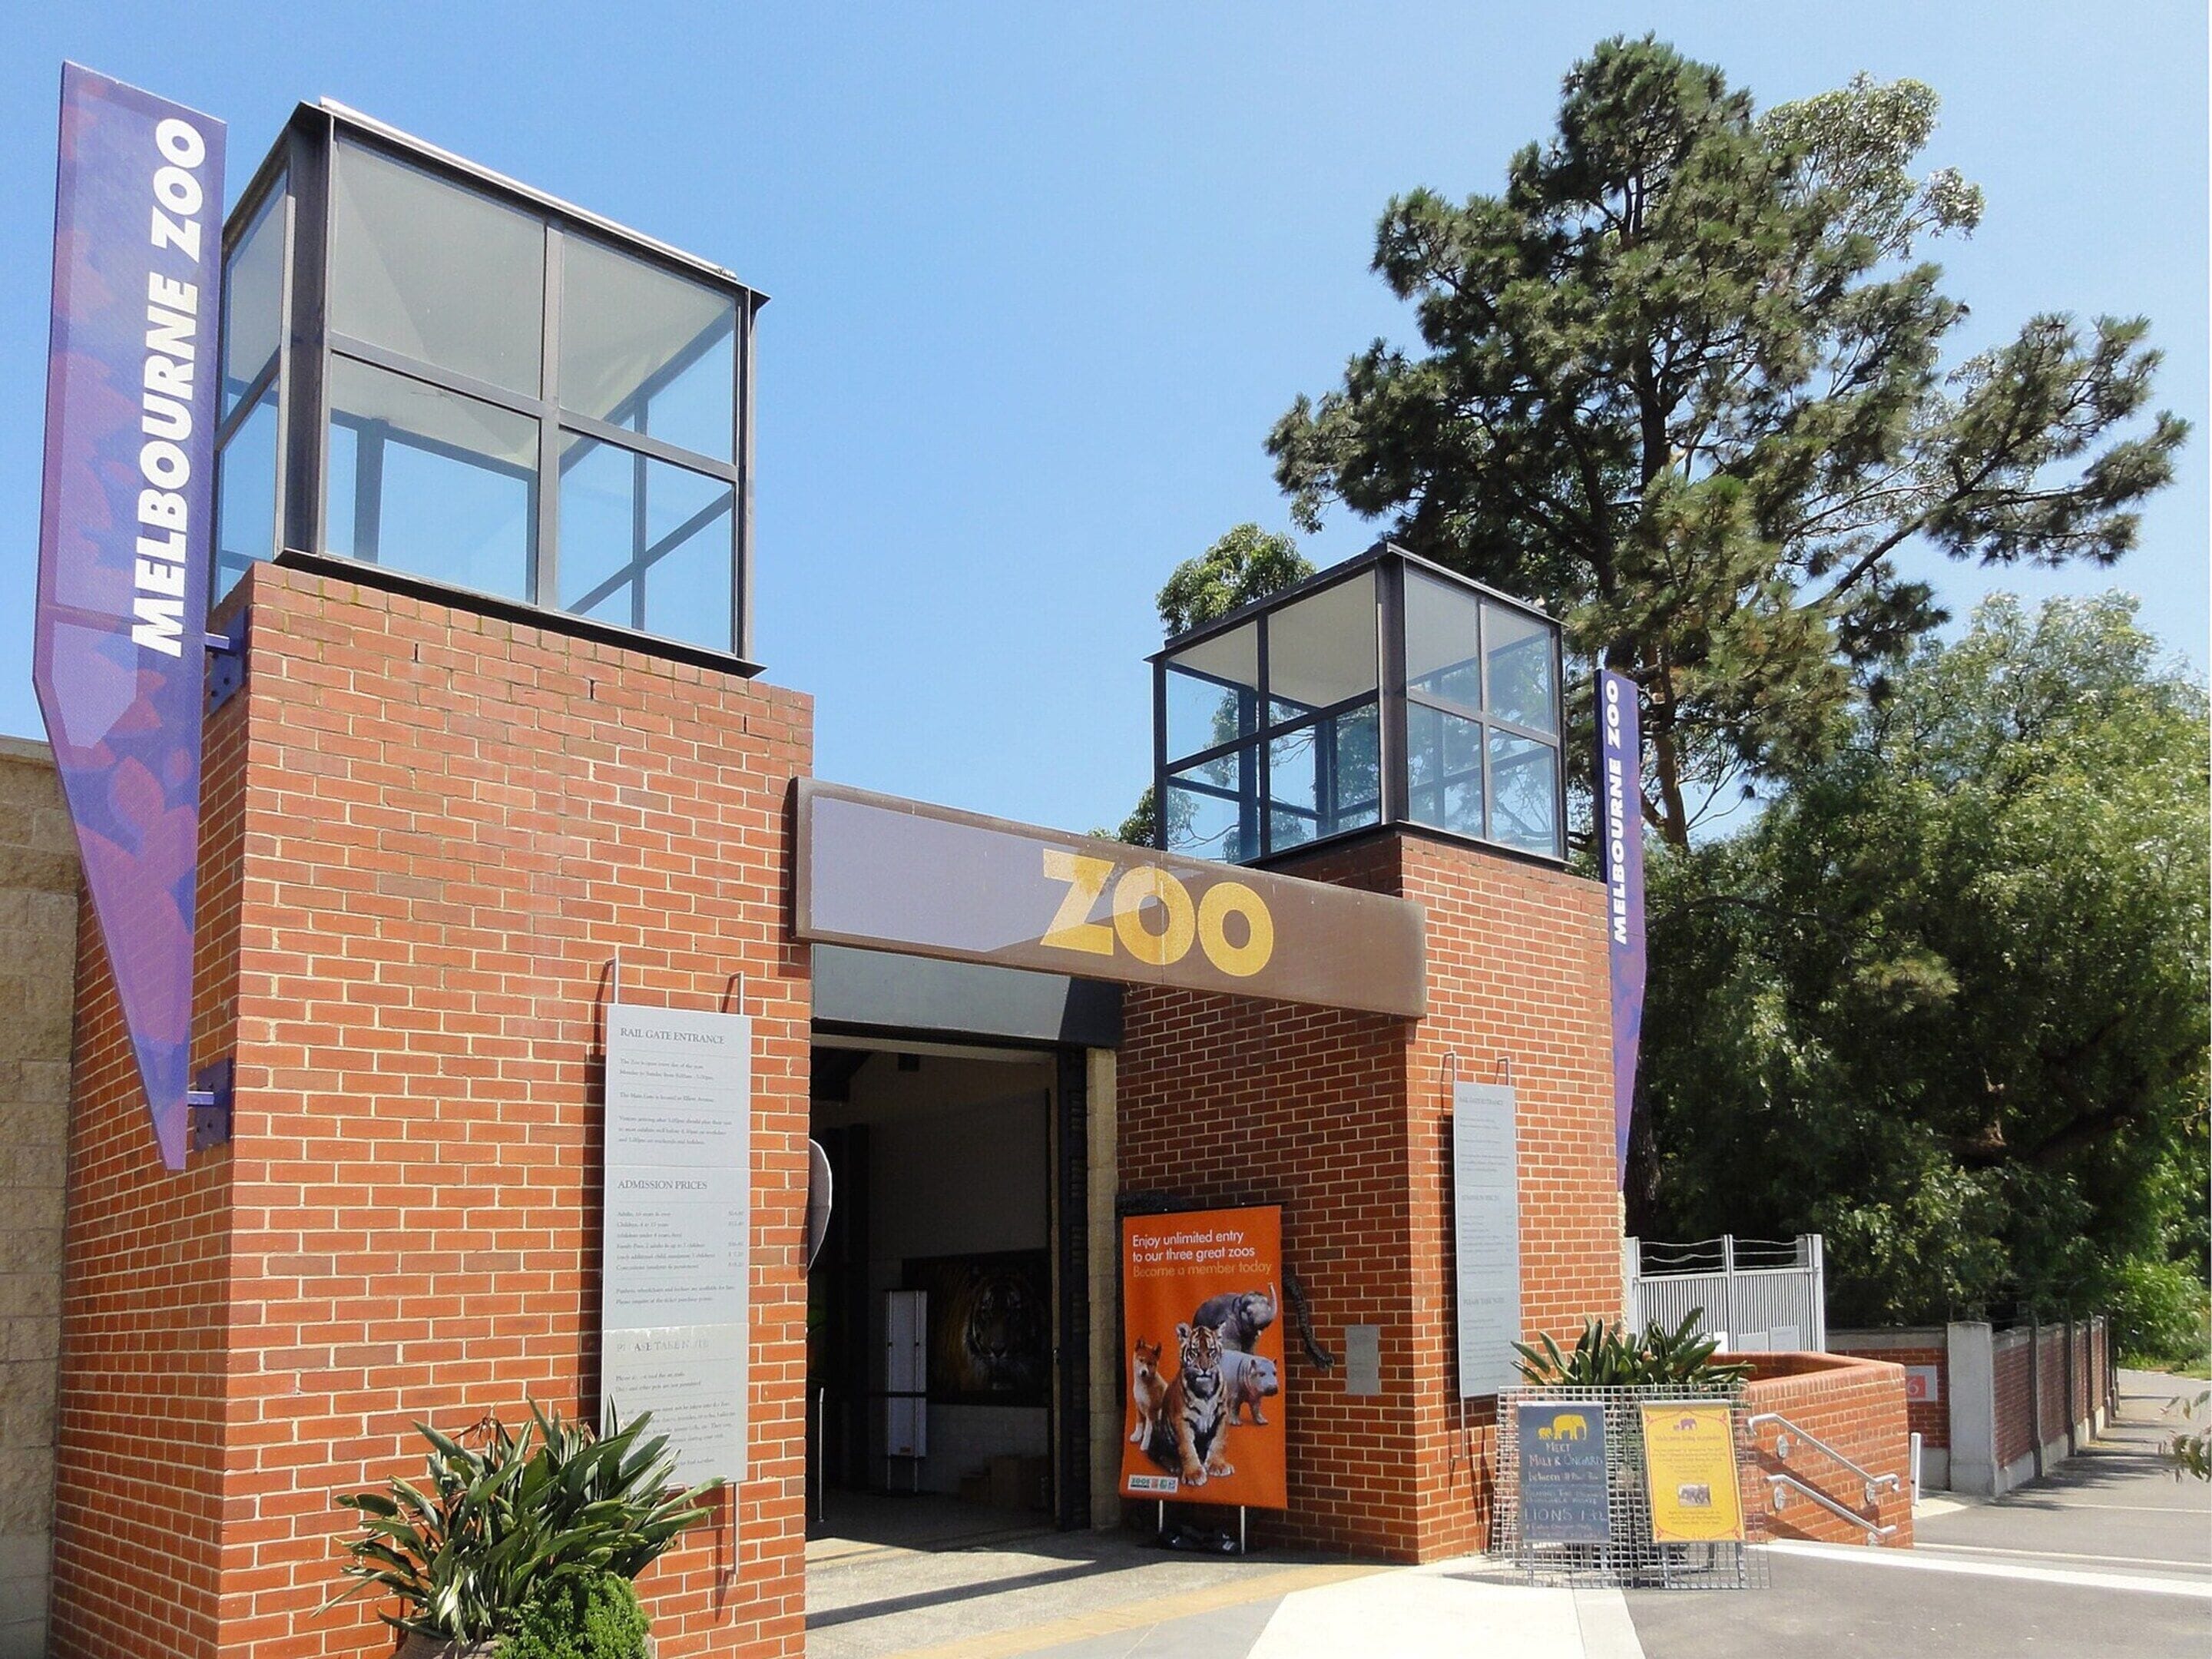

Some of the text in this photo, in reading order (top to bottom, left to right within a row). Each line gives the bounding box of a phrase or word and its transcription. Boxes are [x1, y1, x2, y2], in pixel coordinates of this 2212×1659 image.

[131, 117, 207, 658] MELBOURNE ZOO
[1606, 680, 1627, 945] MELBOURNE ZOO
[1040, 848, 1274, 977] ZOO
[620, 1028, 725, 1045] RAIL GATE ENTRANCE
[618, 1180, 707, 1190] ADMISSION PRICES
[1133, 1230, 1244, 1249] Enjoy unlimited entry
[1133, 1247, 1255, 1263] to our three great zoos
[1133, 1259, 1272, 1278] Become a member today
